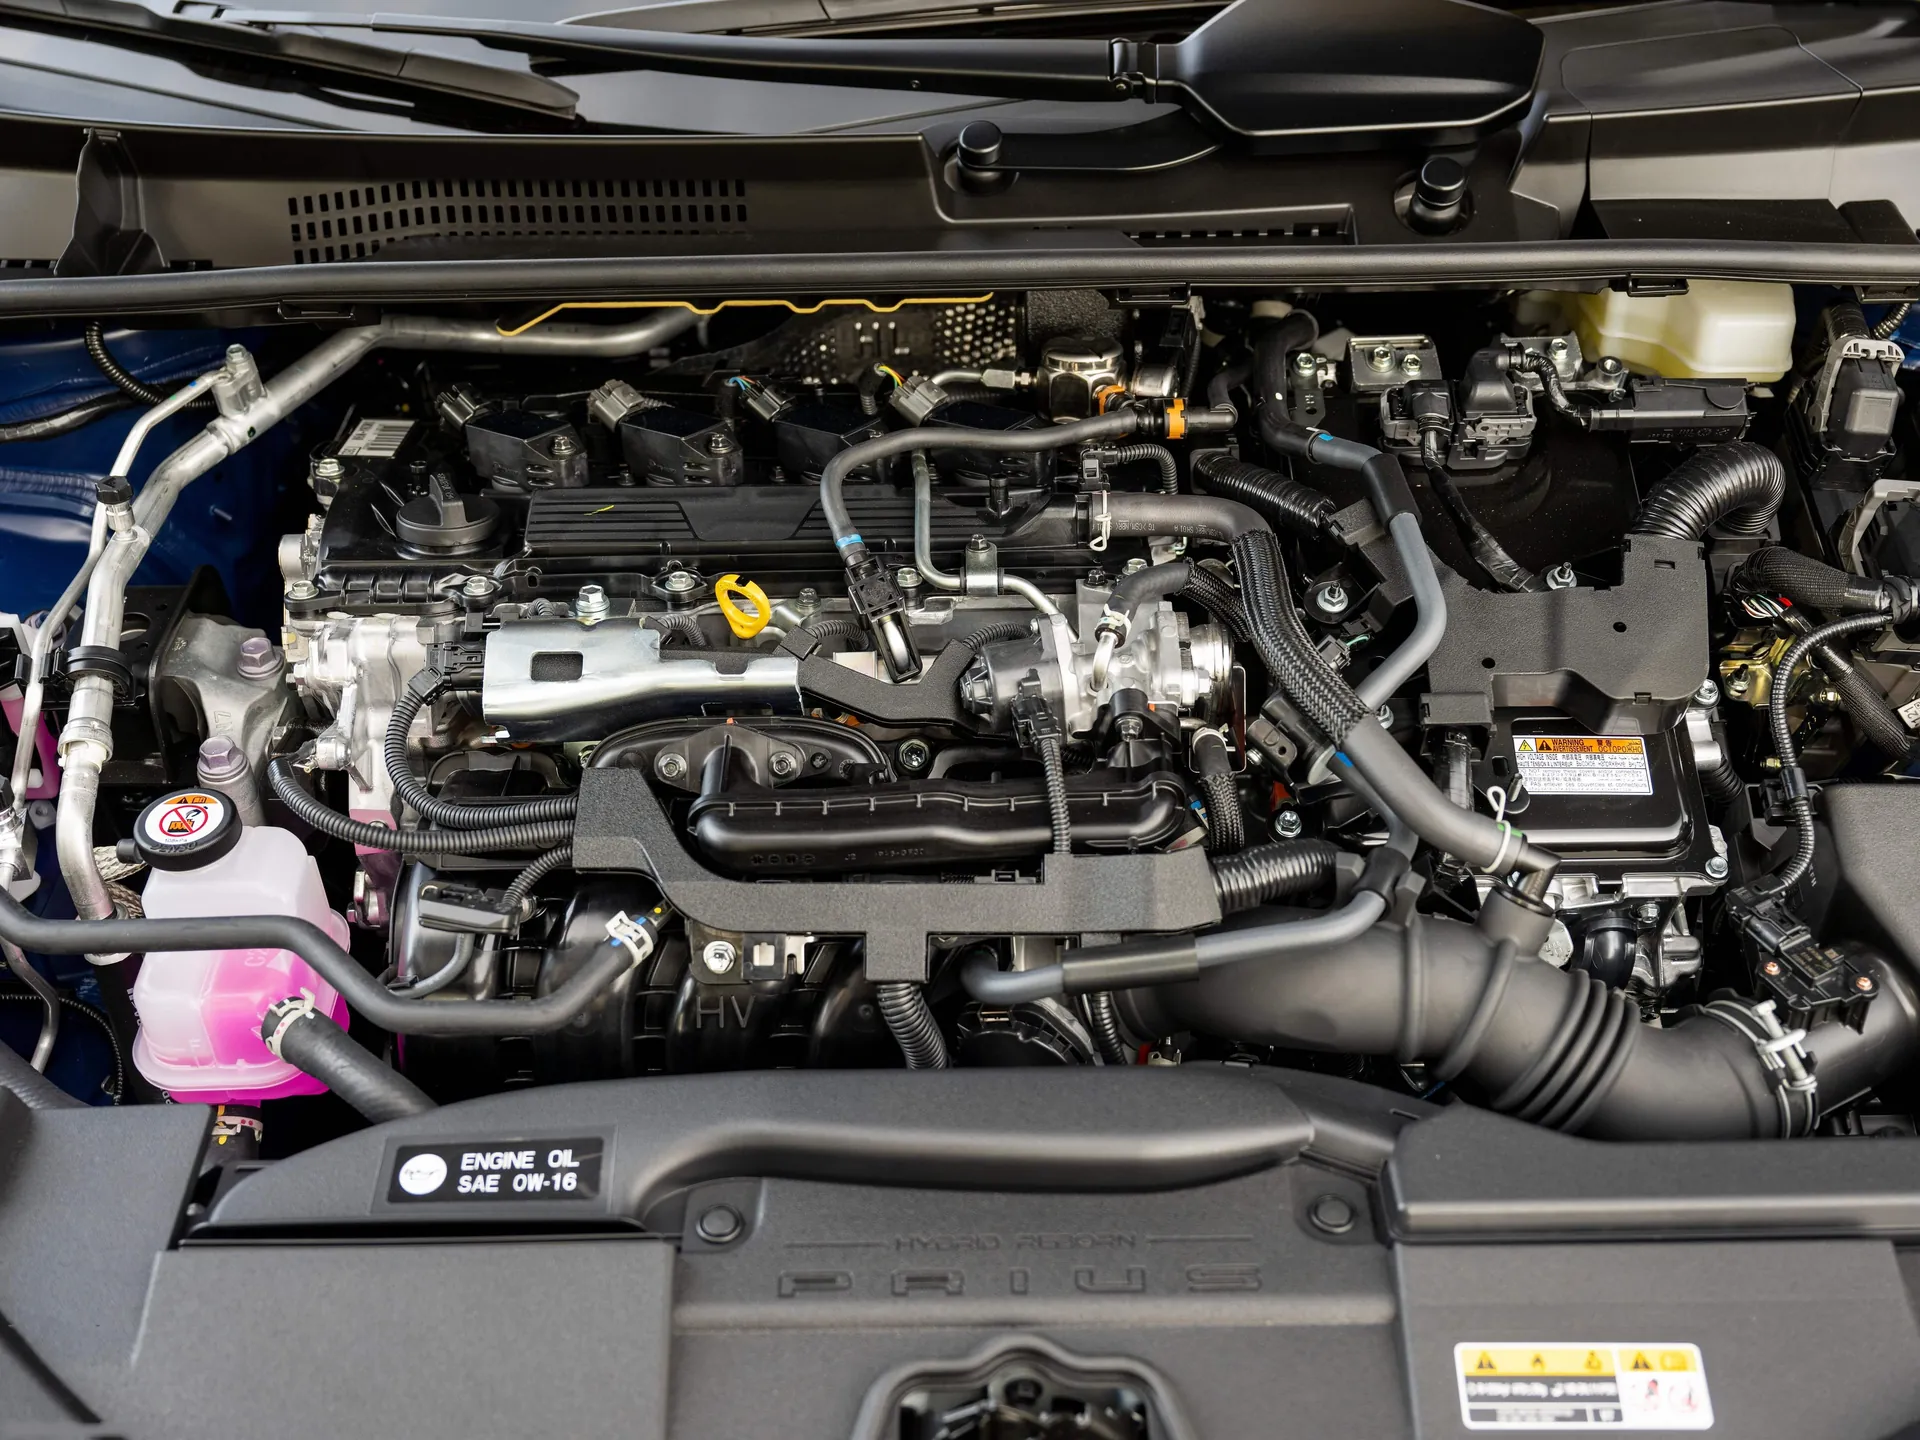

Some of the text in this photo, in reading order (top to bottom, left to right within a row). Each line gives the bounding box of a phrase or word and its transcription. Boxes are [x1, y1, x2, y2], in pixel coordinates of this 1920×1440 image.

[696, 995, 756, 1029] HV
[461, 1149, 579, 1171] ENGINE OIL
[457, 1172, 577, 1193] SAE 0W-16
[1013, 1230, 1137, 1249] REBORN
[777, 1262, 1263, 1298] PRIUS
